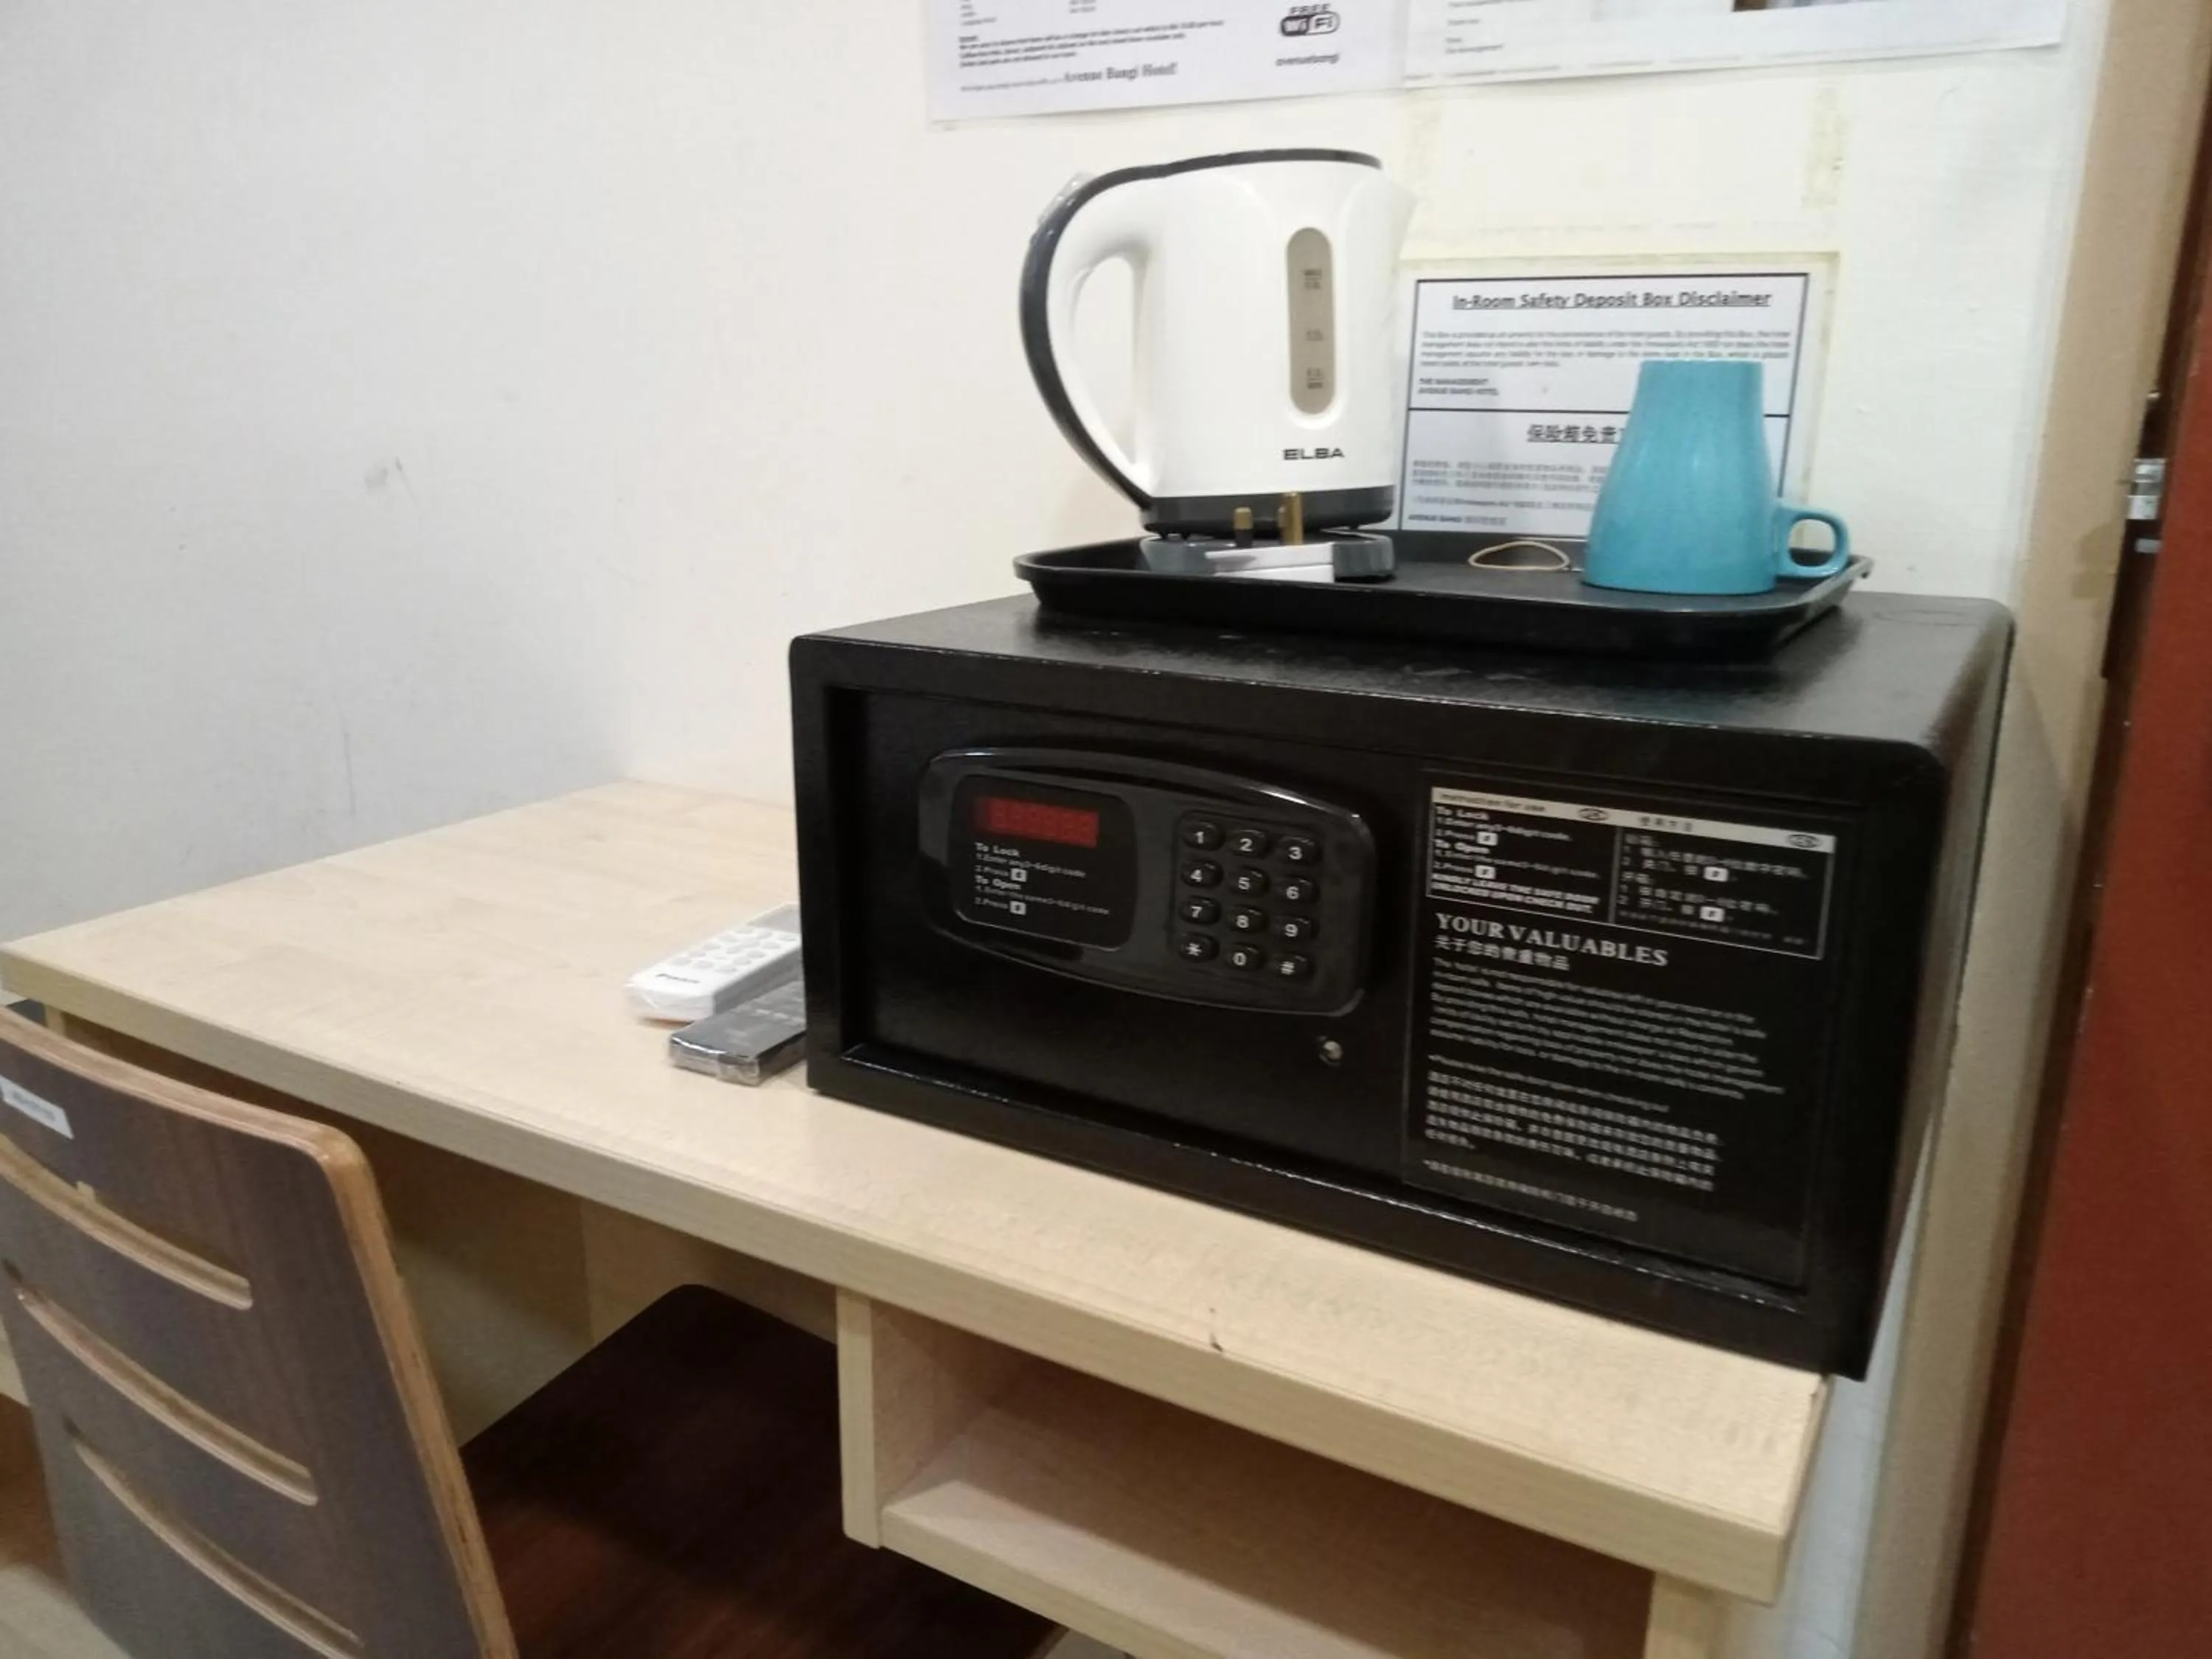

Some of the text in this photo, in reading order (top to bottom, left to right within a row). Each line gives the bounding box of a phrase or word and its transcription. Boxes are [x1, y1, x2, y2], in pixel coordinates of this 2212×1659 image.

[1453, 290, 1773, 309] In-Room Safety Deposit Box Disclaimer
[1282, 447, 1346, 461] ELBA
[1195, 831, 1205, 844] 1
[1239, 838, 1253, 852] 2
[1288, 846, 1303, 860] 3
[1190, 869, 1203, 883] 4
[1238, 877, 1251, 891] 5
[1286, 886, 1299, 900] 6
[1191, 905, 1203, 918] 7
[1237, 914, 1249, 928] 8
[1285, 924, 1298, 938] 9
[1435, 912, 1505, 939] YOUR
[1507, 924, 1669, 967] VALUABLES
[1233, 952, 1247, 967] 0
